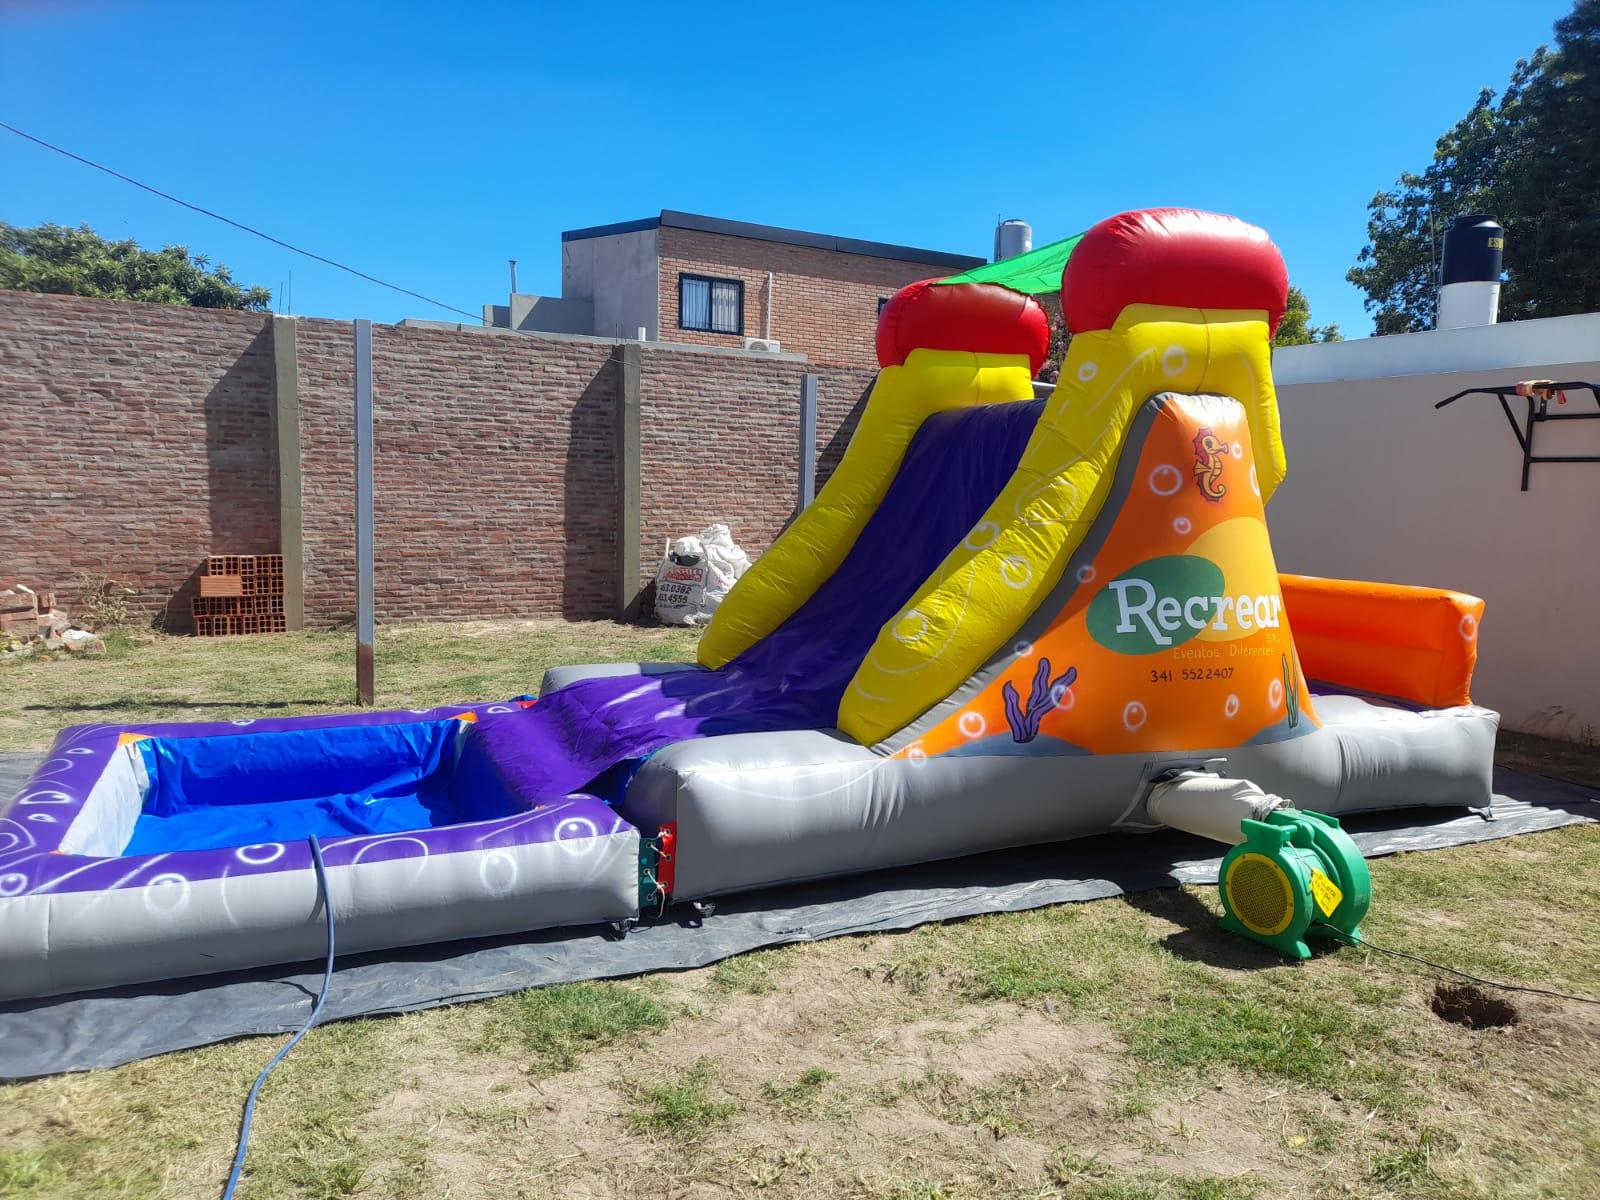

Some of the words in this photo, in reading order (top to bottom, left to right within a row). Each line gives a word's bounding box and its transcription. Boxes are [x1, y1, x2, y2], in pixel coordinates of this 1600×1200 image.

[1108, 578, 1282, 645] Recrear
[1173, 647, 1220, 660] Eventos
[1229, 643, 1276, 657] Diferentes
[1150, 669, 1173, 683] 341
[1181, 667, 1234, 681] 5522407
